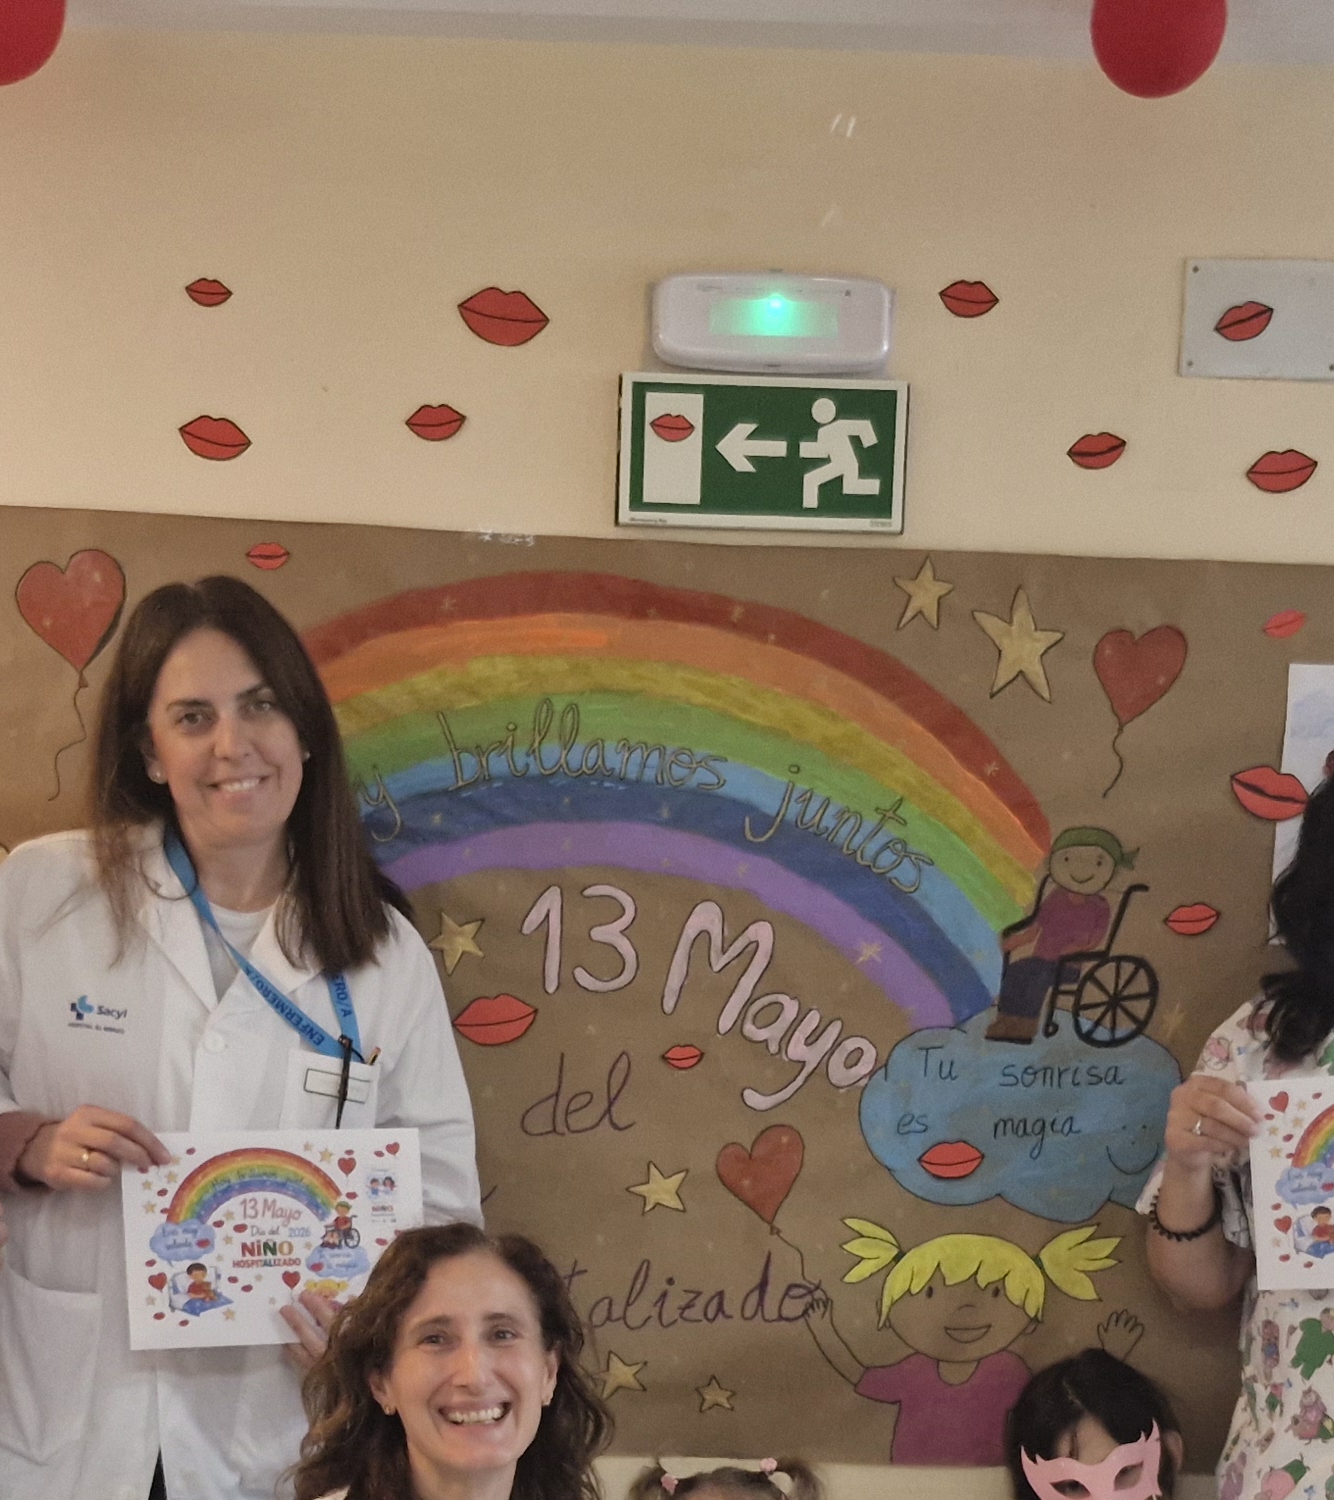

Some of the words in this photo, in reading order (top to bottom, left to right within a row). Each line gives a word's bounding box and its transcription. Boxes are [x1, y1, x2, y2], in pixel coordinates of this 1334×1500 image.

[437, 699, 729, 792] brillamos
[744, 765, 935, 894] juntos
[520, 884, 639, 994] 13
[661, 900, 878, 1112] Mayo
[520, 1050, 637, 1136] del
[918, 1045, 959, 1081] Tu
[999, 1060, 1127, 1089] sonrisa
[896, 1113, 929, 1135] es
[993, 1111, 1081, 1160] magia
[239, 1197, 258, 1219] 13
[262, 1198, 303, 1227] Mayo
[562, 1250, 819, 1330] talizado
